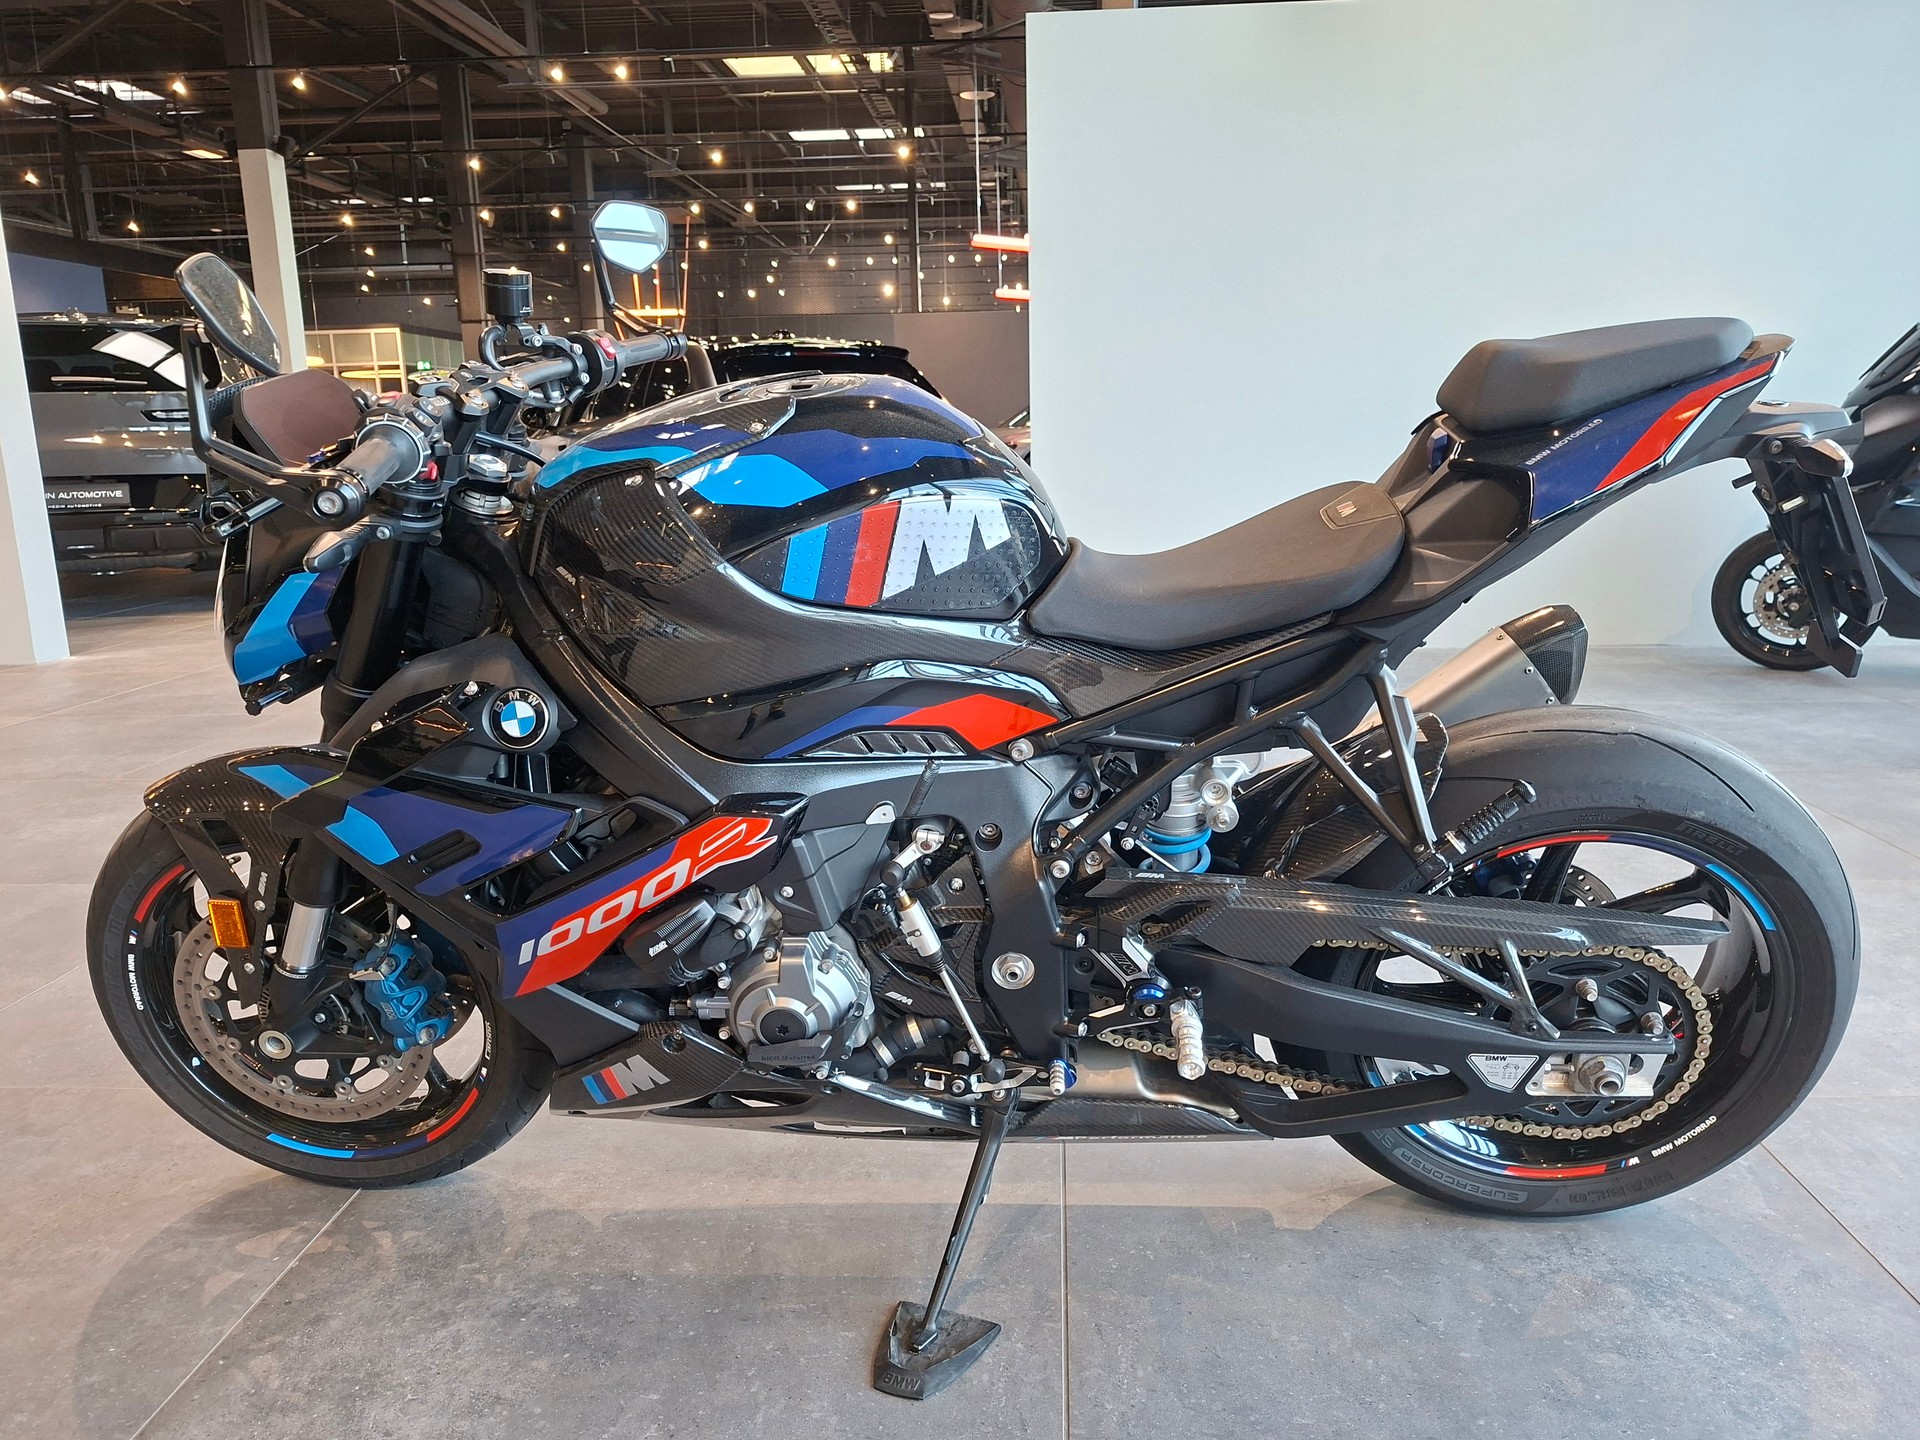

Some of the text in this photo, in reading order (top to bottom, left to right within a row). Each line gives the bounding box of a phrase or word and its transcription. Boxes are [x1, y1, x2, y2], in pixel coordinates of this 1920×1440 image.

[1525, 418, 1603, 465] BMW MOTORRAD
[58, 490, 123, 499] AUTOMOTIVE
[494, 690, 539, 713] BMW
[1674, 820, 1749, 857] PIRELLI
[127, 953, 144, 1011] BMW MOTORRAD
[1651, 1115, 1718, 1158] BMW MOTORRAD
[1400, 1150, 1520, 1202] SUPERCORSA
[883, 1372, 921, 1391] BMW
